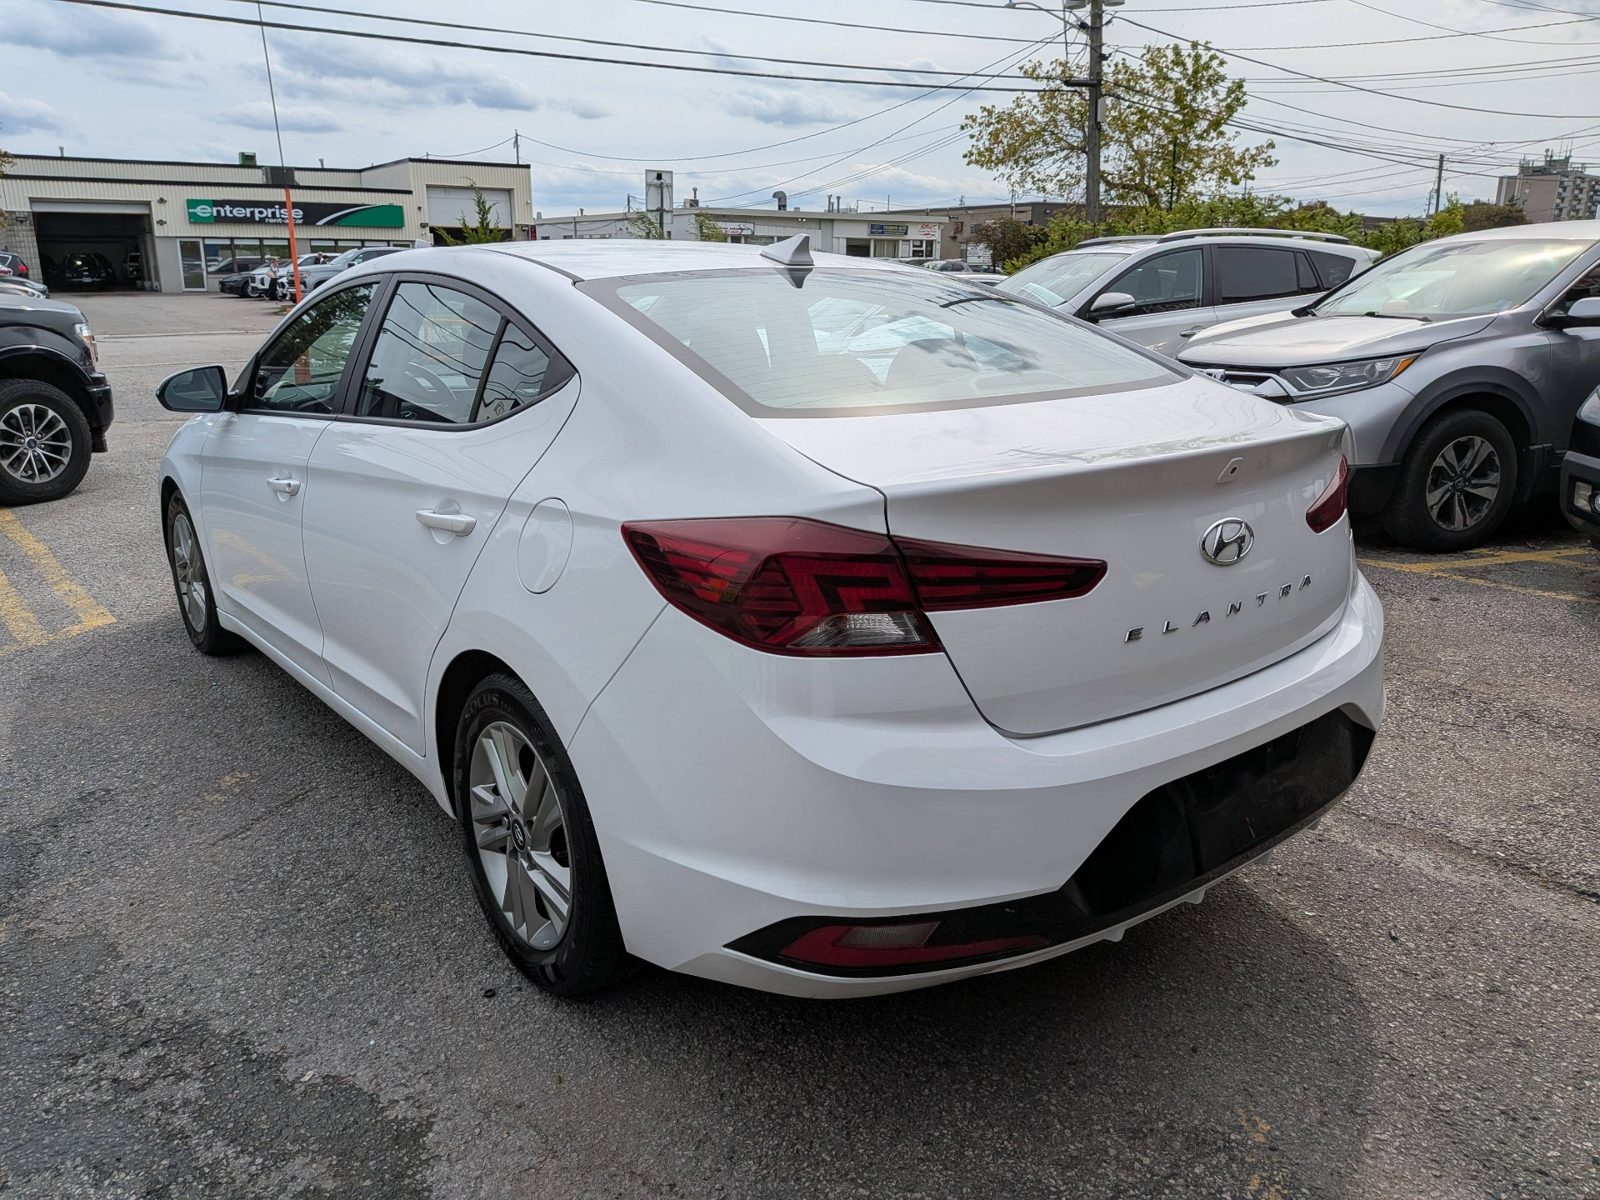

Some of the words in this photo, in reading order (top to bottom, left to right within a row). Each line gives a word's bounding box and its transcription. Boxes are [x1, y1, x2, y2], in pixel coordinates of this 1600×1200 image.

[189, 205, 304, 221] enterprise
[1124, 574, 1312, 644] ELANTRA
[463, 691, 500, 721] SOLUS
